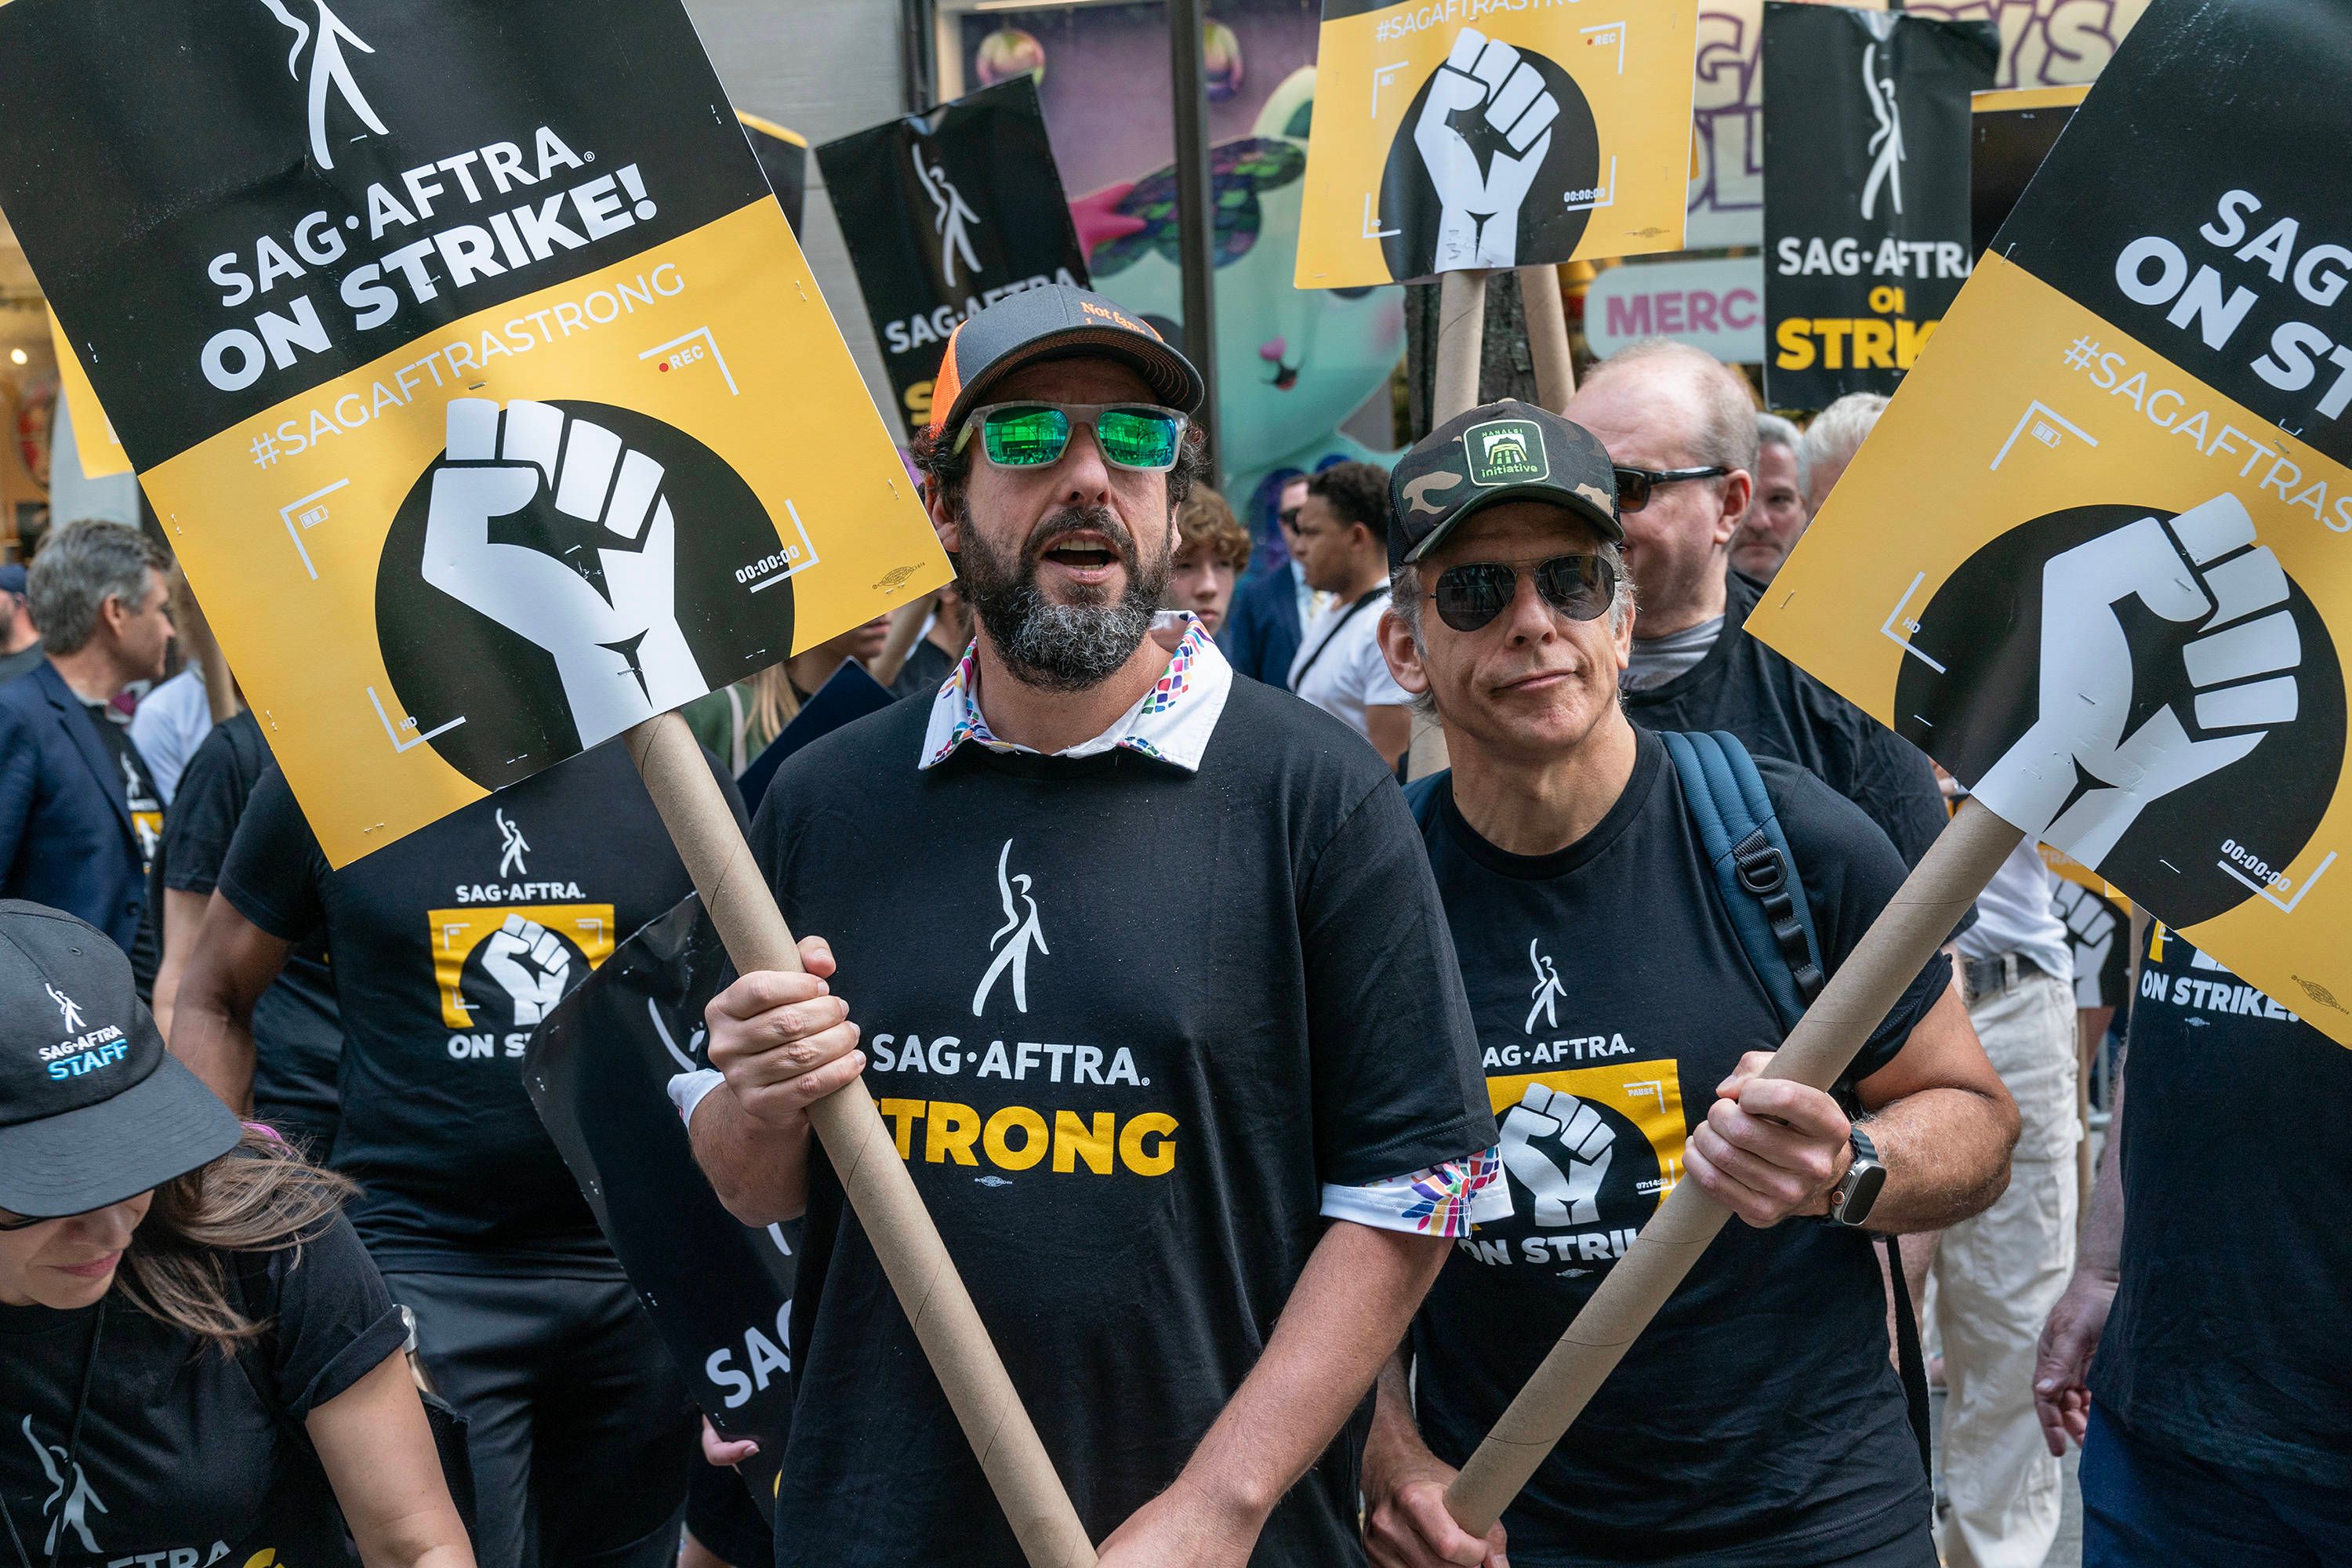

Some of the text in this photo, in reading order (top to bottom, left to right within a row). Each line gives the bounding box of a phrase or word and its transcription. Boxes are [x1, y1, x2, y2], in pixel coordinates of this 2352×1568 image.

[1595, 32, 1616, 46] REC
[1563, 187, 1606, 203] 00:00:00
[200, 163, 658, 392] ON STRIKE!
[2114, 235, 2259, 352] ON
[1080, 301, 1112, 320] Not
[1606, 289, 1763, 337] MERC
[249, 263, 684, 470] #SAGAFTRASTRONG
[669, 345, 704, 370] REC
[1480, 463, 1538, 478] initiative
[735, 545, 800, 584] 00:00:00
[1902, 616, 1921, 633] HD
[398, 716, 418, 731] HD
[2220, 839, 2292, 892] 00:00:00
[2141, 969, 2169, 1002] ON
[47, 1038, 129, 1081] STAFF
[447, 1033, 495, 1058] ON
[1628, 1087, 1654, 1097] PAUSE
[873, 1098, 1180, 1177] TRONG
